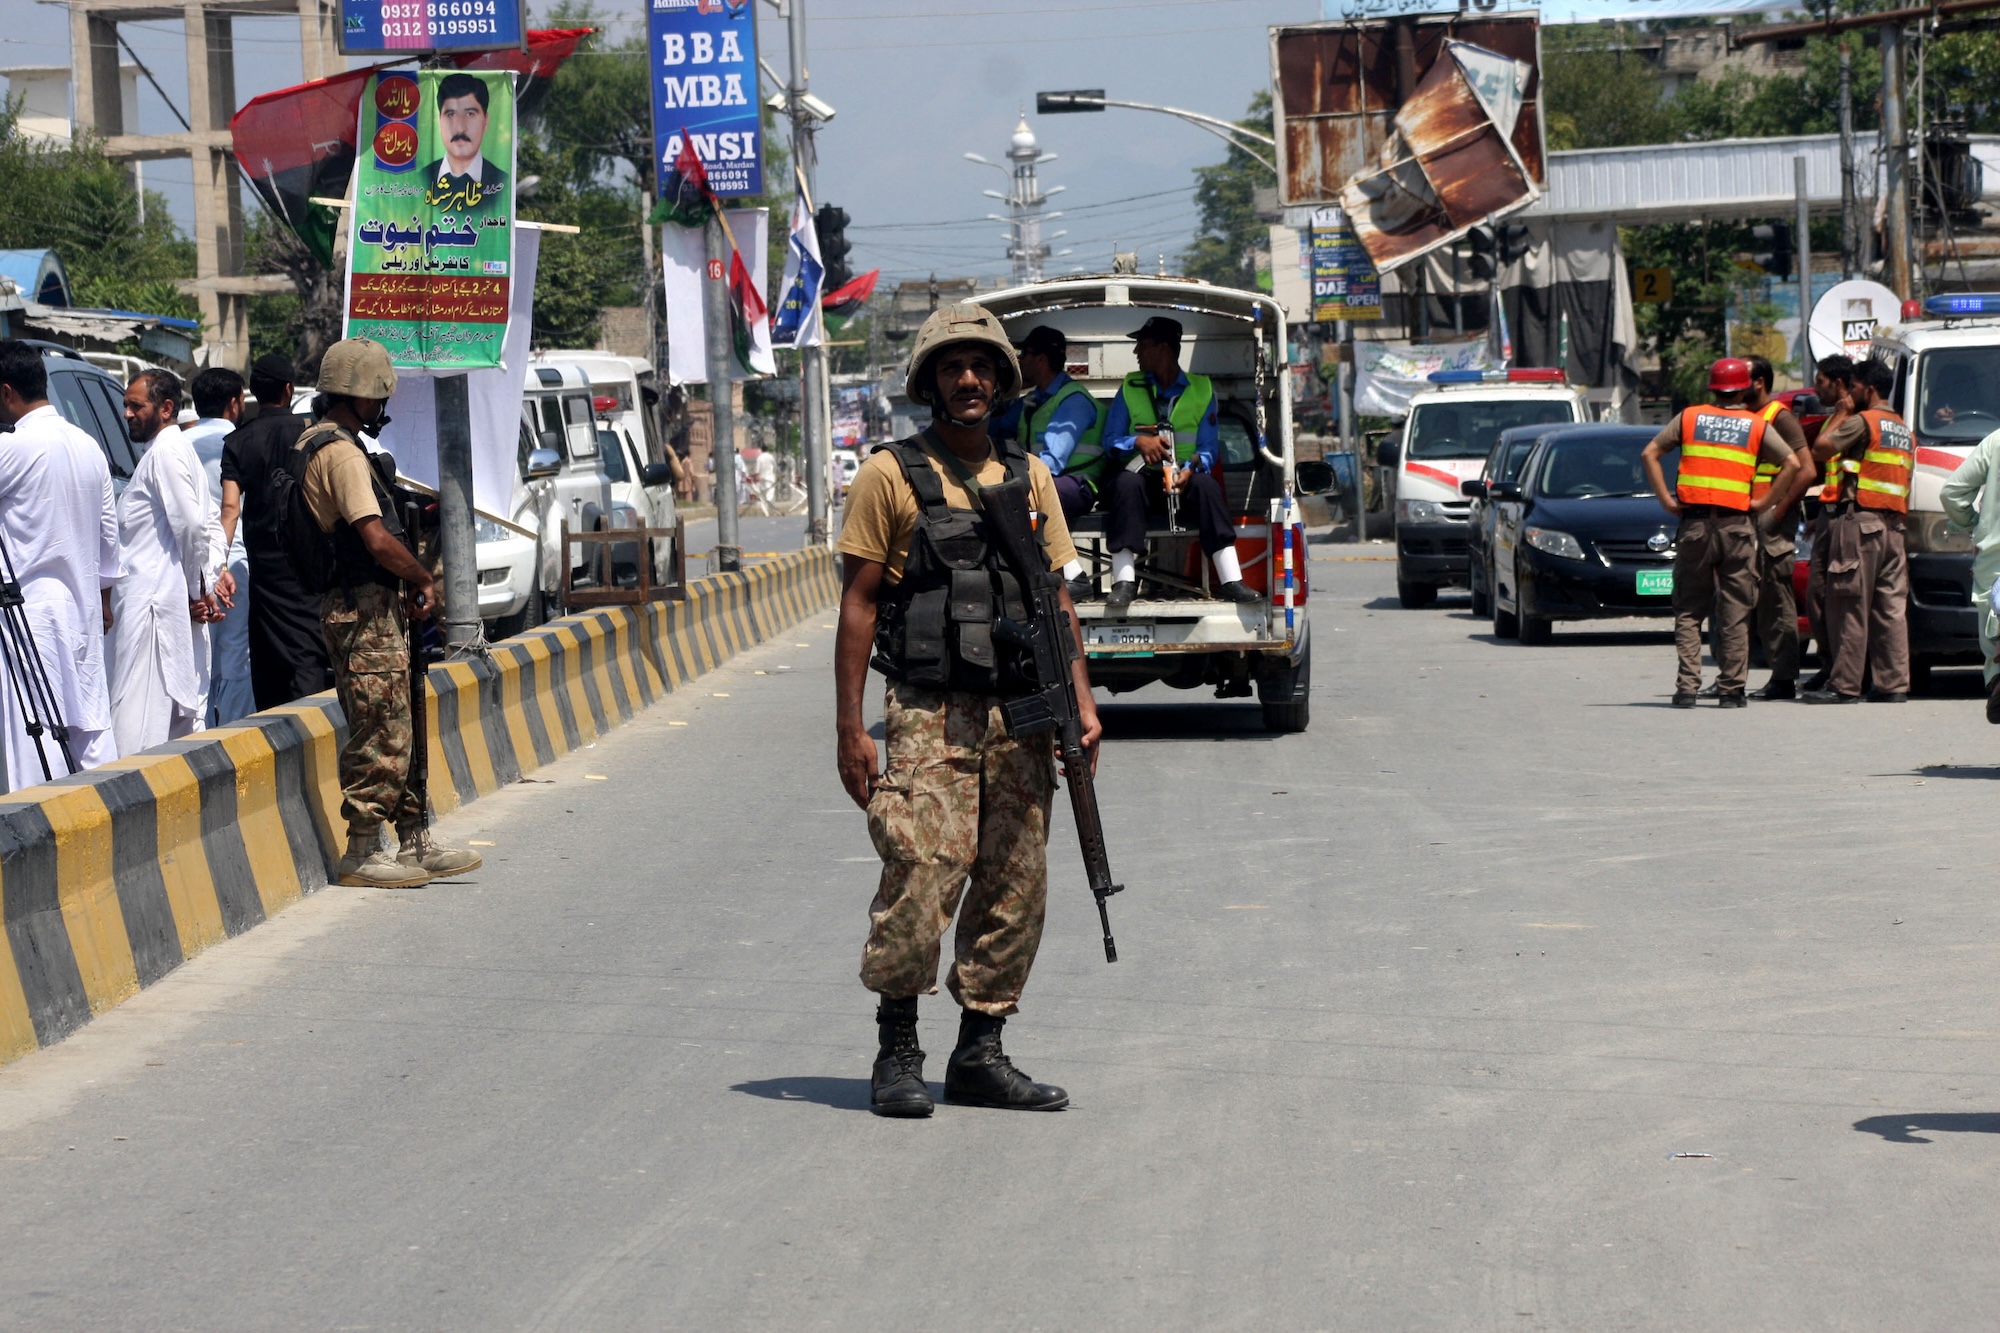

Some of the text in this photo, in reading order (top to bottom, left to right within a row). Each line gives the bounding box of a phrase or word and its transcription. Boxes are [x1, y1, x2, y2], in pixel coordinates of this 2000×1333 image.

[381, 1, 496, 19] 0937 866094
[381, 19, 497, 36] 0312 9195951
[662, 30, 744, 66] BBA
[663, 74, 747, 108] MBA
[662, 132, 756, 163] ANSI
[726, 161, 755, 169] Mardan
[707, 170, 748, 180] 866094
[479, 215, 507, 230] تاجدار
[358, 215, 480, 257] ختم نبوت
[381, 255, 407, 272] ریلی
[409, 256, 423, 271] اور
[708, 263, 721, 278] 16
[432, 279, 458, 298] پاکستان
[472, 282, 479, 294] 2
[492, 282, 501, 294] 4
[1314, 281, 1347, 296] DAE
[1643, 273, 1658, 296] 2
[1346, 294, 1379, 306] OPEN
[1844, 320, 1876, 341] ARY
[1696, 414, 1753, 433] RESCUE
[1704, 428, 1739, 444] 1122
[1889, 434, 1909, 450] 1122
